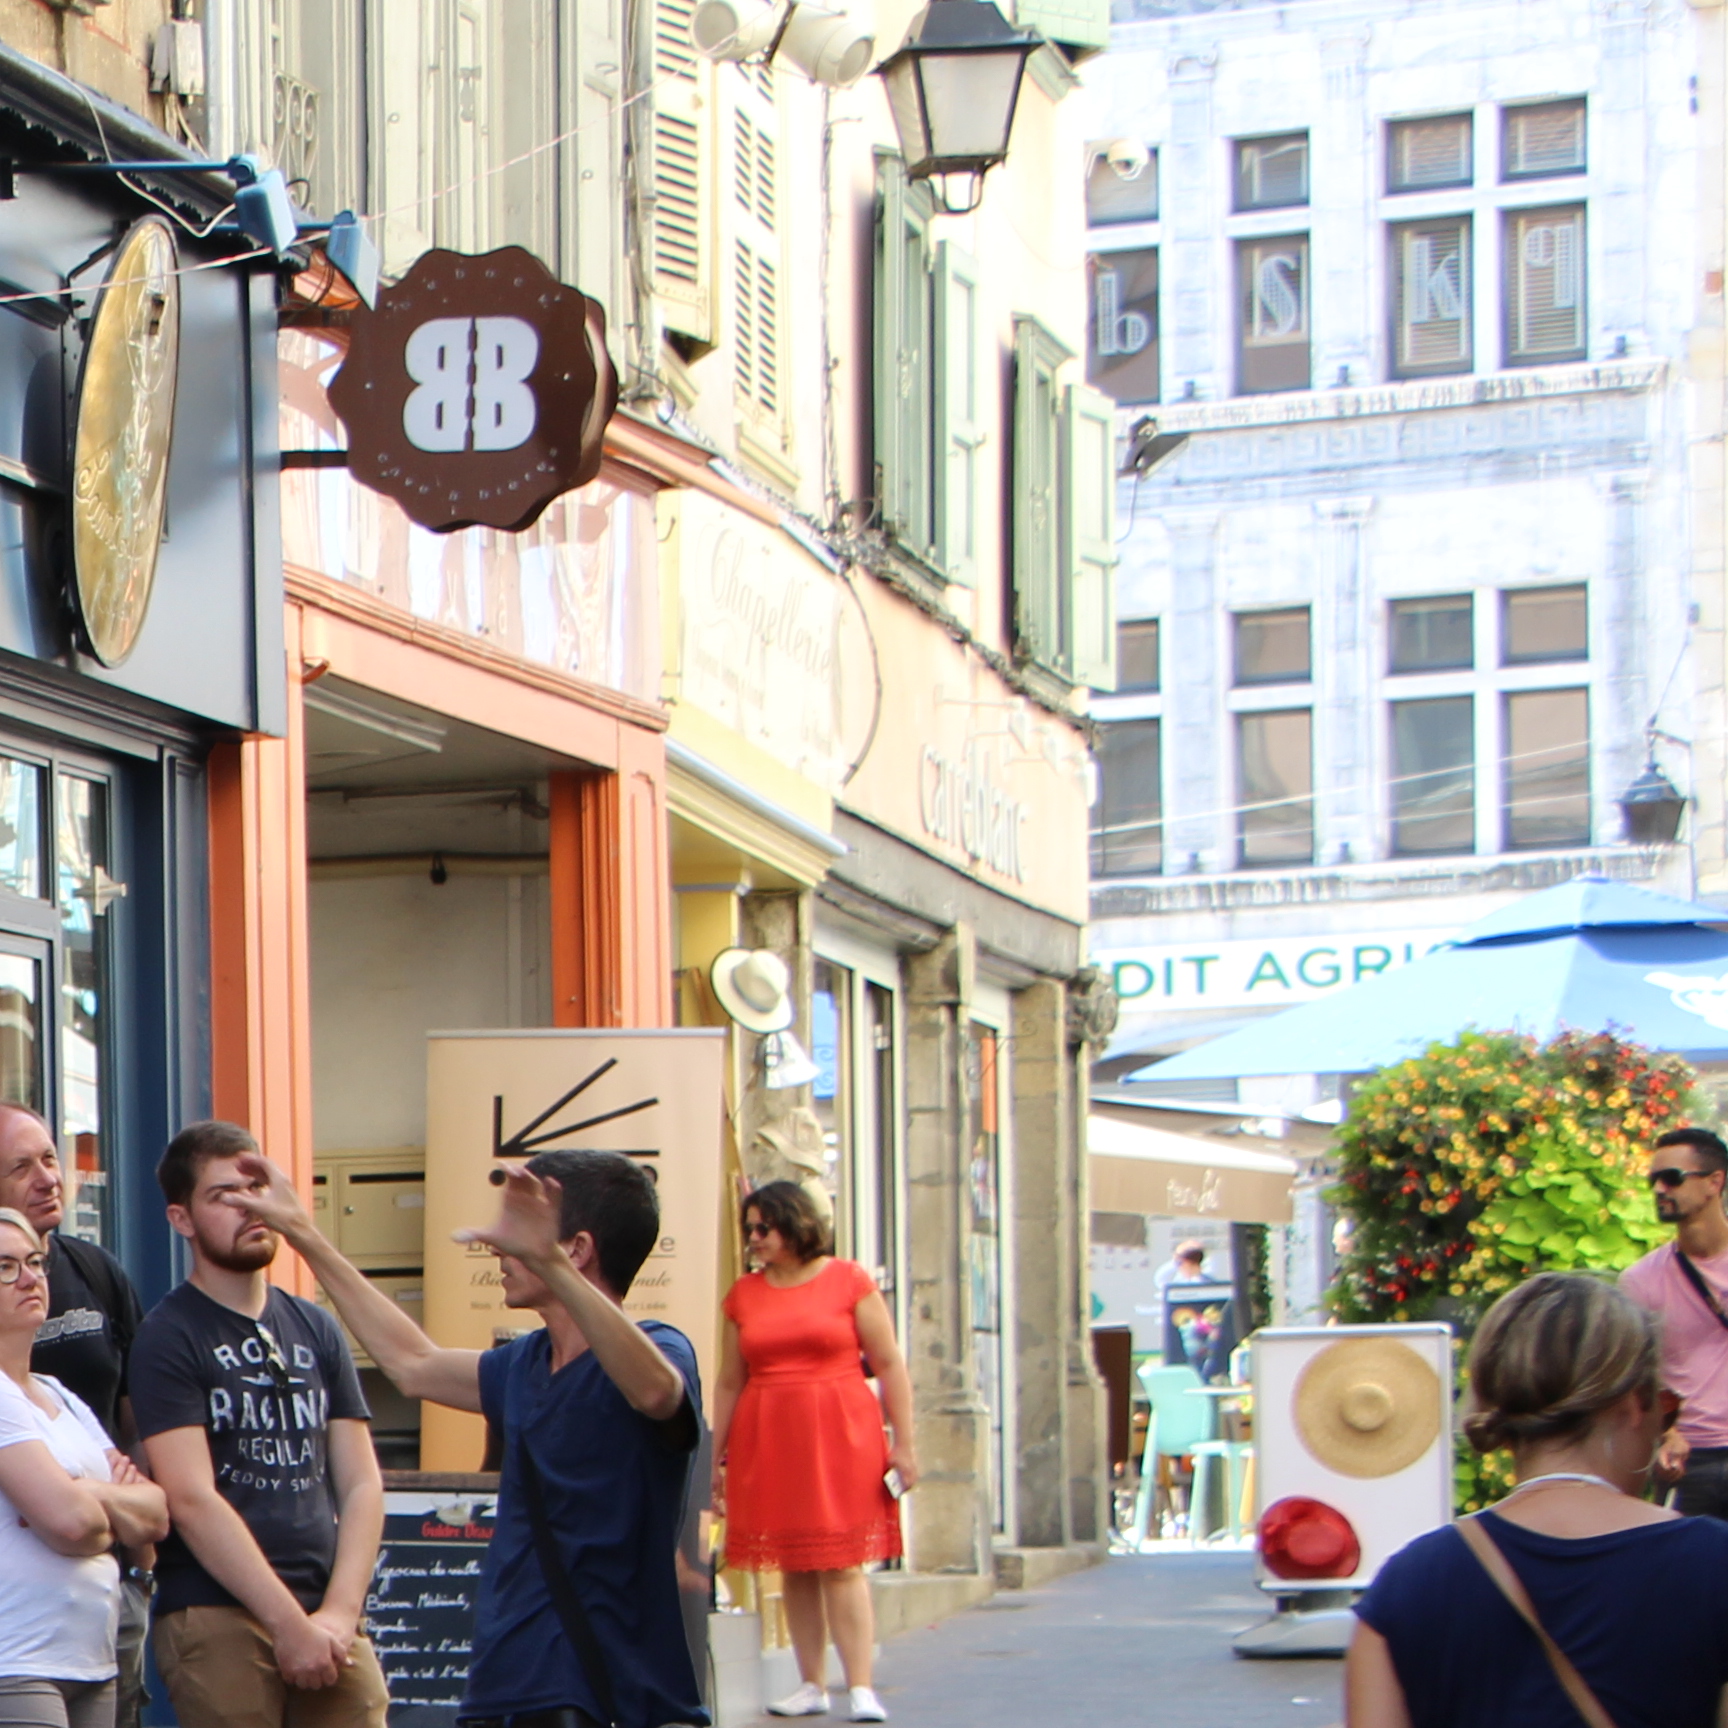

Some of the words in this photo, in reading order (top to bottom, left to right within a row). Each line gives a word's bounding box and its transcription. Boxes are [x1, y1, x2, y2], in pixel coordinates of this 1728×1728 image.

[696, 523, 832, 684] Chapellerie
[1089, 956, 1221, 999] DIT
[1244, 940, 1461, 990] AGRI
[238, 1437, 317, 1467] REGULA
[220, 1463, 281, 1491] TEDDY
